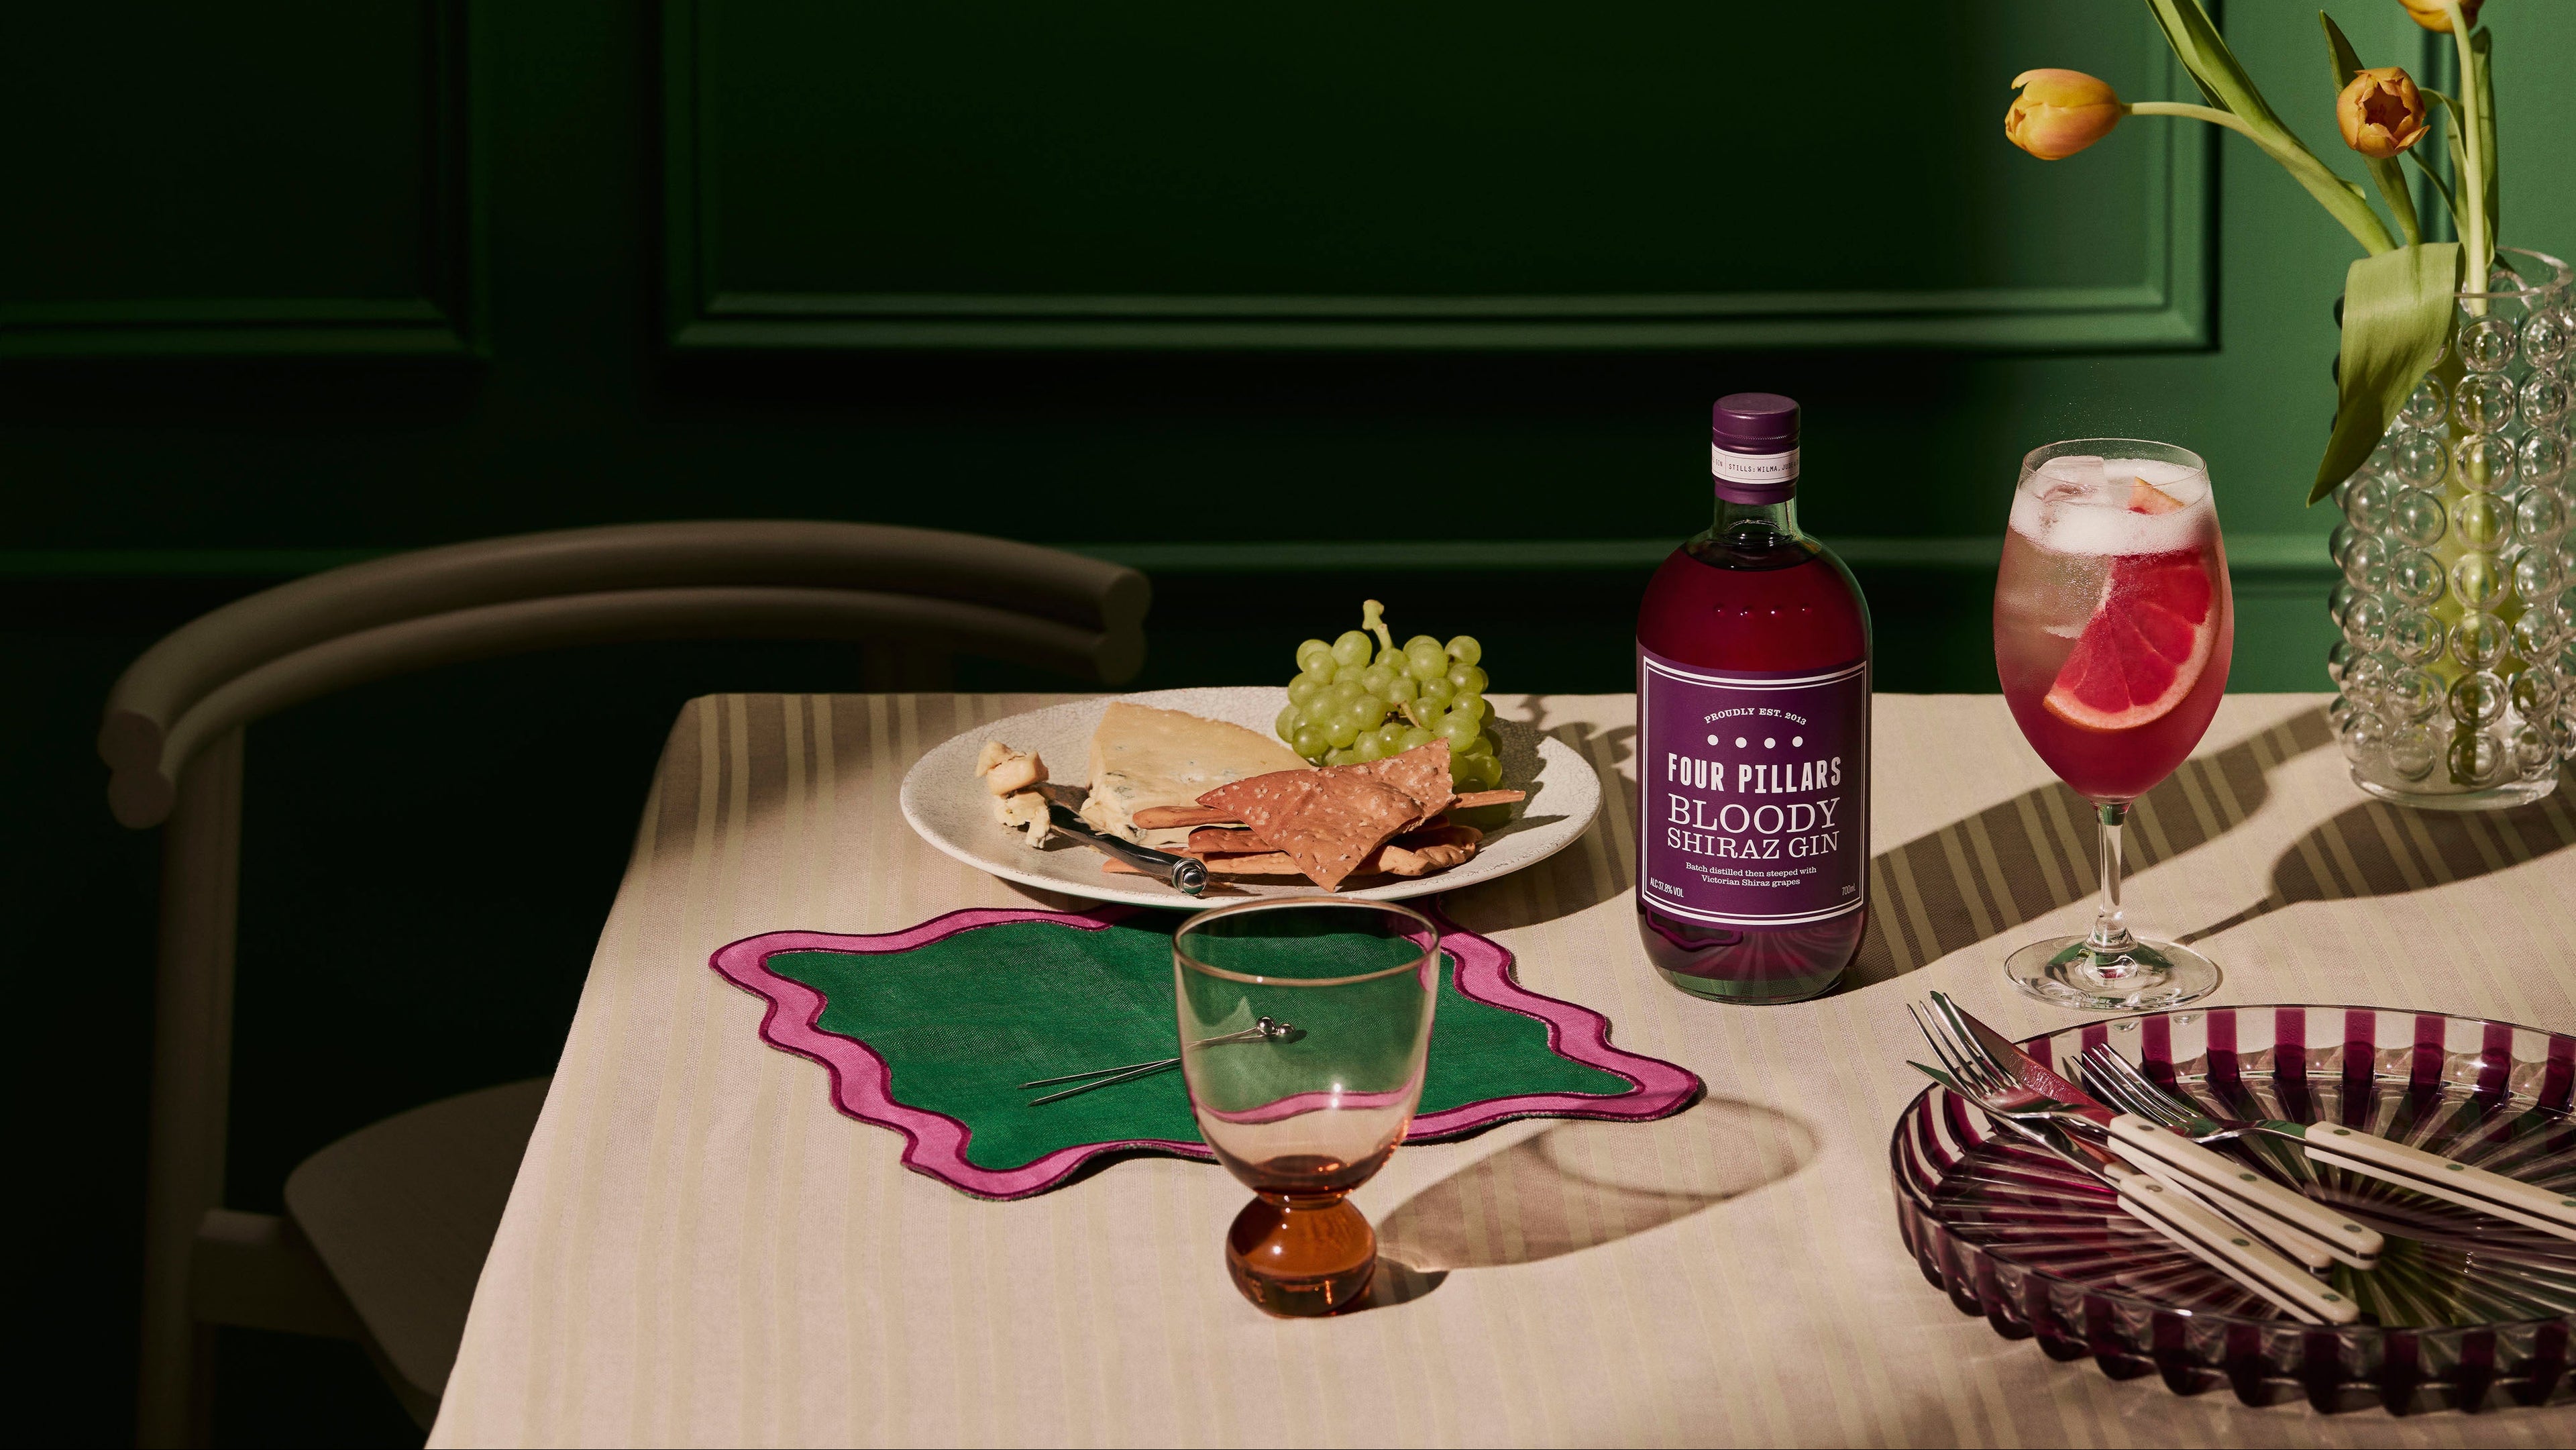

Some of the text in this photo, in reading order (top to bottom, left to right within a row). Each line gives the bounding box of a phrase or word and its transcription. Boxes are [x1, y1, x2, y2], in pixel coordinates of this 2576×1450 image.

[1729, 463, 1755, 472] STILLS:
[1704, 708, 1807, 725] PROUDLY EST. 2013
[1668, 752, 1841, 794] FOUR PILLARS
[1668, 792, 1841, 834] BLOODY
[1667, 827, 1840, 859] SHIRAZ GIN
[1685, 862, 1708, 872] Batch
[1709, 866, 1743, 876] distilled
[1766, 868, 1799, 878] steeped
[1799, 866, 1817, 874] with
[1650, 877, 1684, 898] ALC 37.8% VOL
[1701, 874, 1801, 888] Victorian Shiraz grapes
